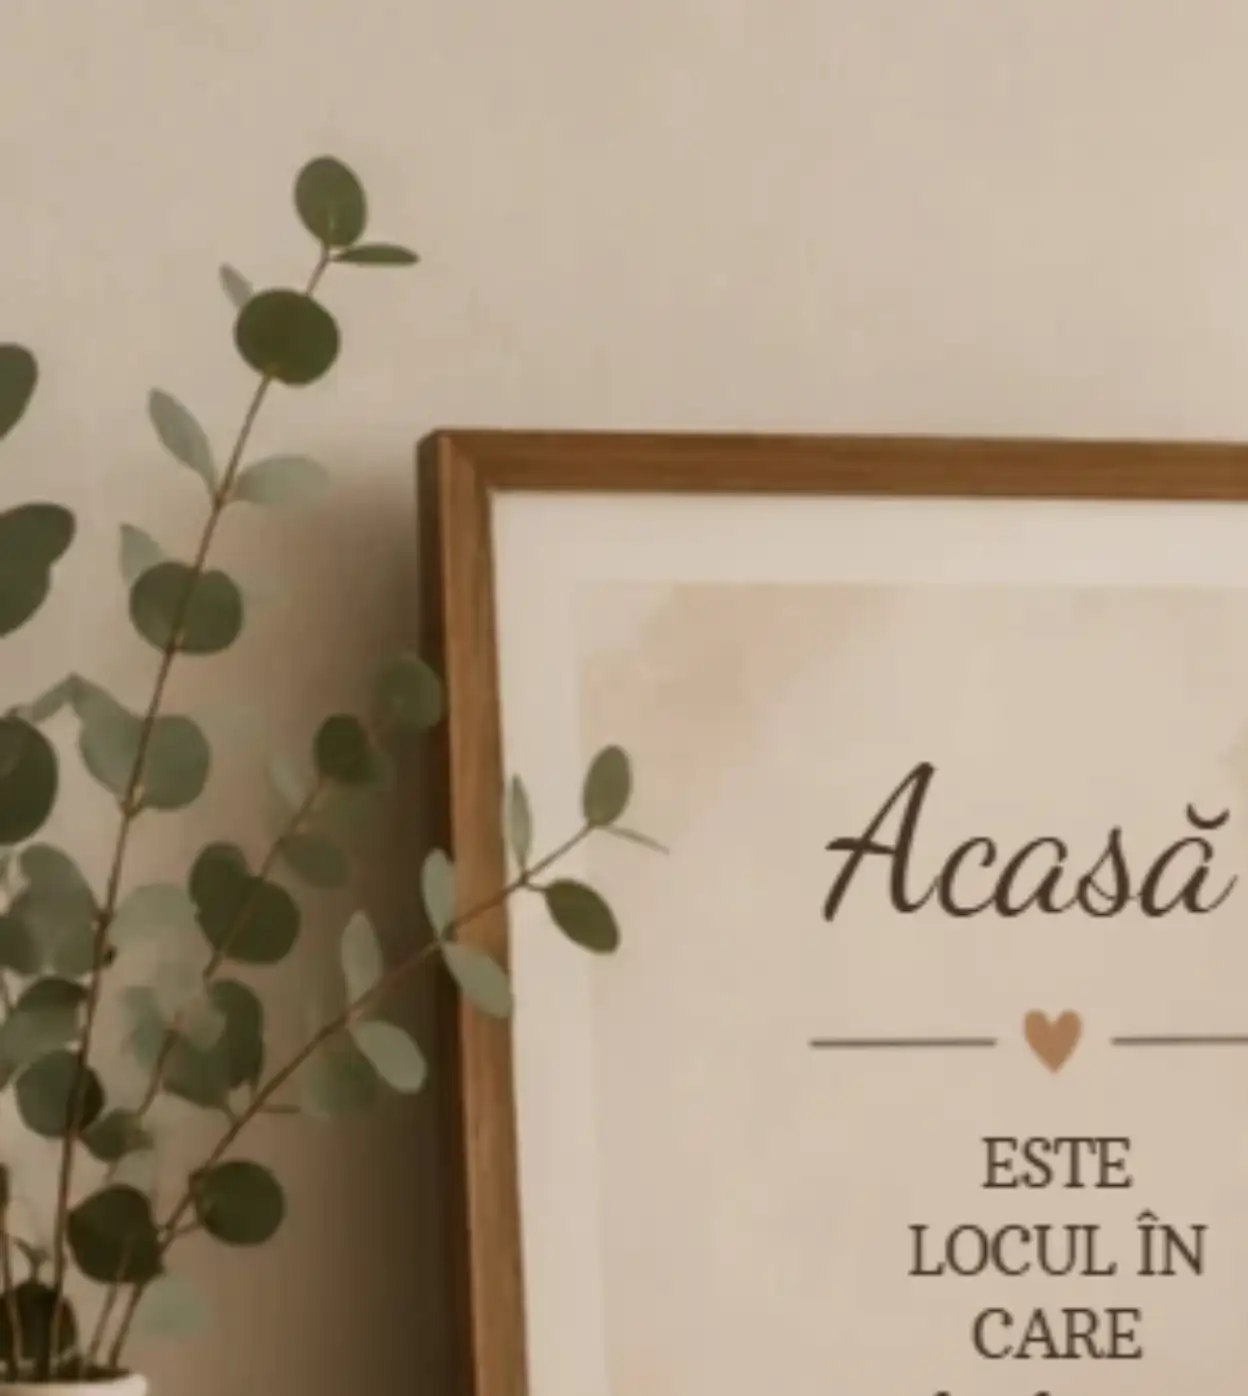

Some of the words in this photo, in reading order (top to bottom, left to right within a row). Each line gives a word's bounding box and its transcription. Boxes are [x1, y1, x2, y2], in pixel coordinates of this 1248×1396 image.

[821, 761, 1238, 922] Acasă
[981, 1136, 1133, 1189] ESTE
[908, 1222, 1117, 1277] LOCUL
[1136, 1208, 1208, 1277] ÎN
[972, 1307, 1143, 1360] CARE
